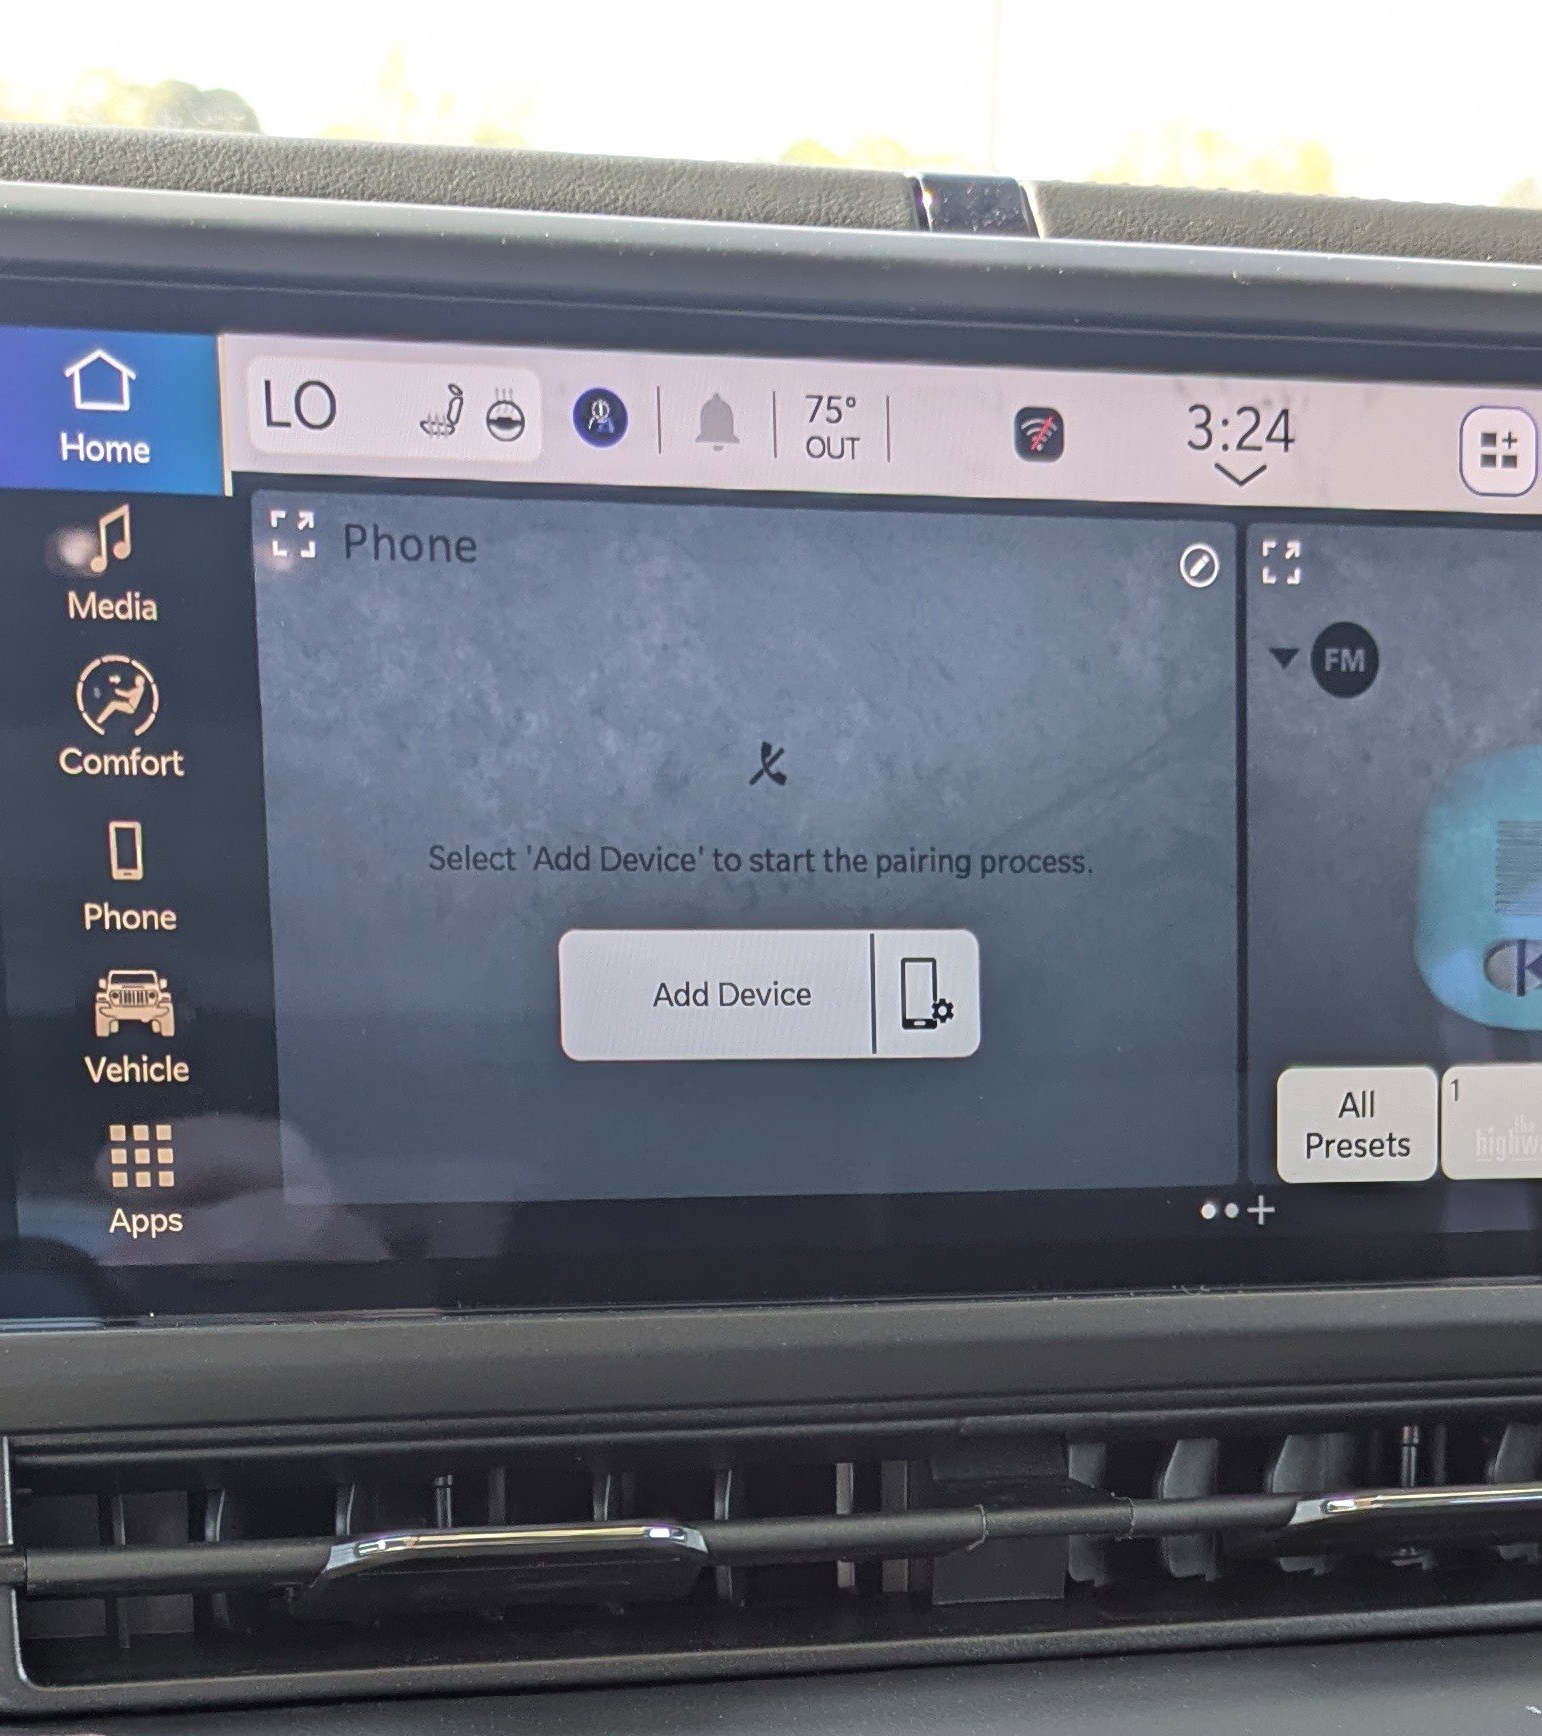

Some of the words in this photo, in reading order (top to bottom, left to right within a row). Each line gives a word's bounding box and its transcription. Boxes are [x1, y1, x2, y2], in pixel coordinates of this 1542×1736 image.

[264, 379, 337, 430] LO
[1187, 404, 1296, 454] 3:24
[60, 433, 150, 464] Home
[806, 437, 861, 461] OUT
[344, 523, 477, 563] Phone
[68, 591, 158, 621] Media
[1324, 648, 1365, 673] FM
[59, 747, 185, 777] Comfort
[429, 845, 516, 873] Select
[526, 845, 591, 873] 'Add
[600, 846, 704, 873] Device'
[713, 849, 742, 873] to
[749, 849, 815, 874] start
[824, 847, 868, 874] the
[876, 848, 971, 879] pairing
[980, 852, 1094, 879] process.
[84, 902, 177, 931] Phone
[653, 982, 709, 1009] Add
[719, 982, 812, 1008] Device
[84, 1055, 190, 1083] Vehicle
[1450, 1078, 1460, 1102] 1
[1339, 1091, 1376, 1120] All
[1306, 1130, 1411, 1161] Presets
[109, 1208, 183, 1238] Apps
